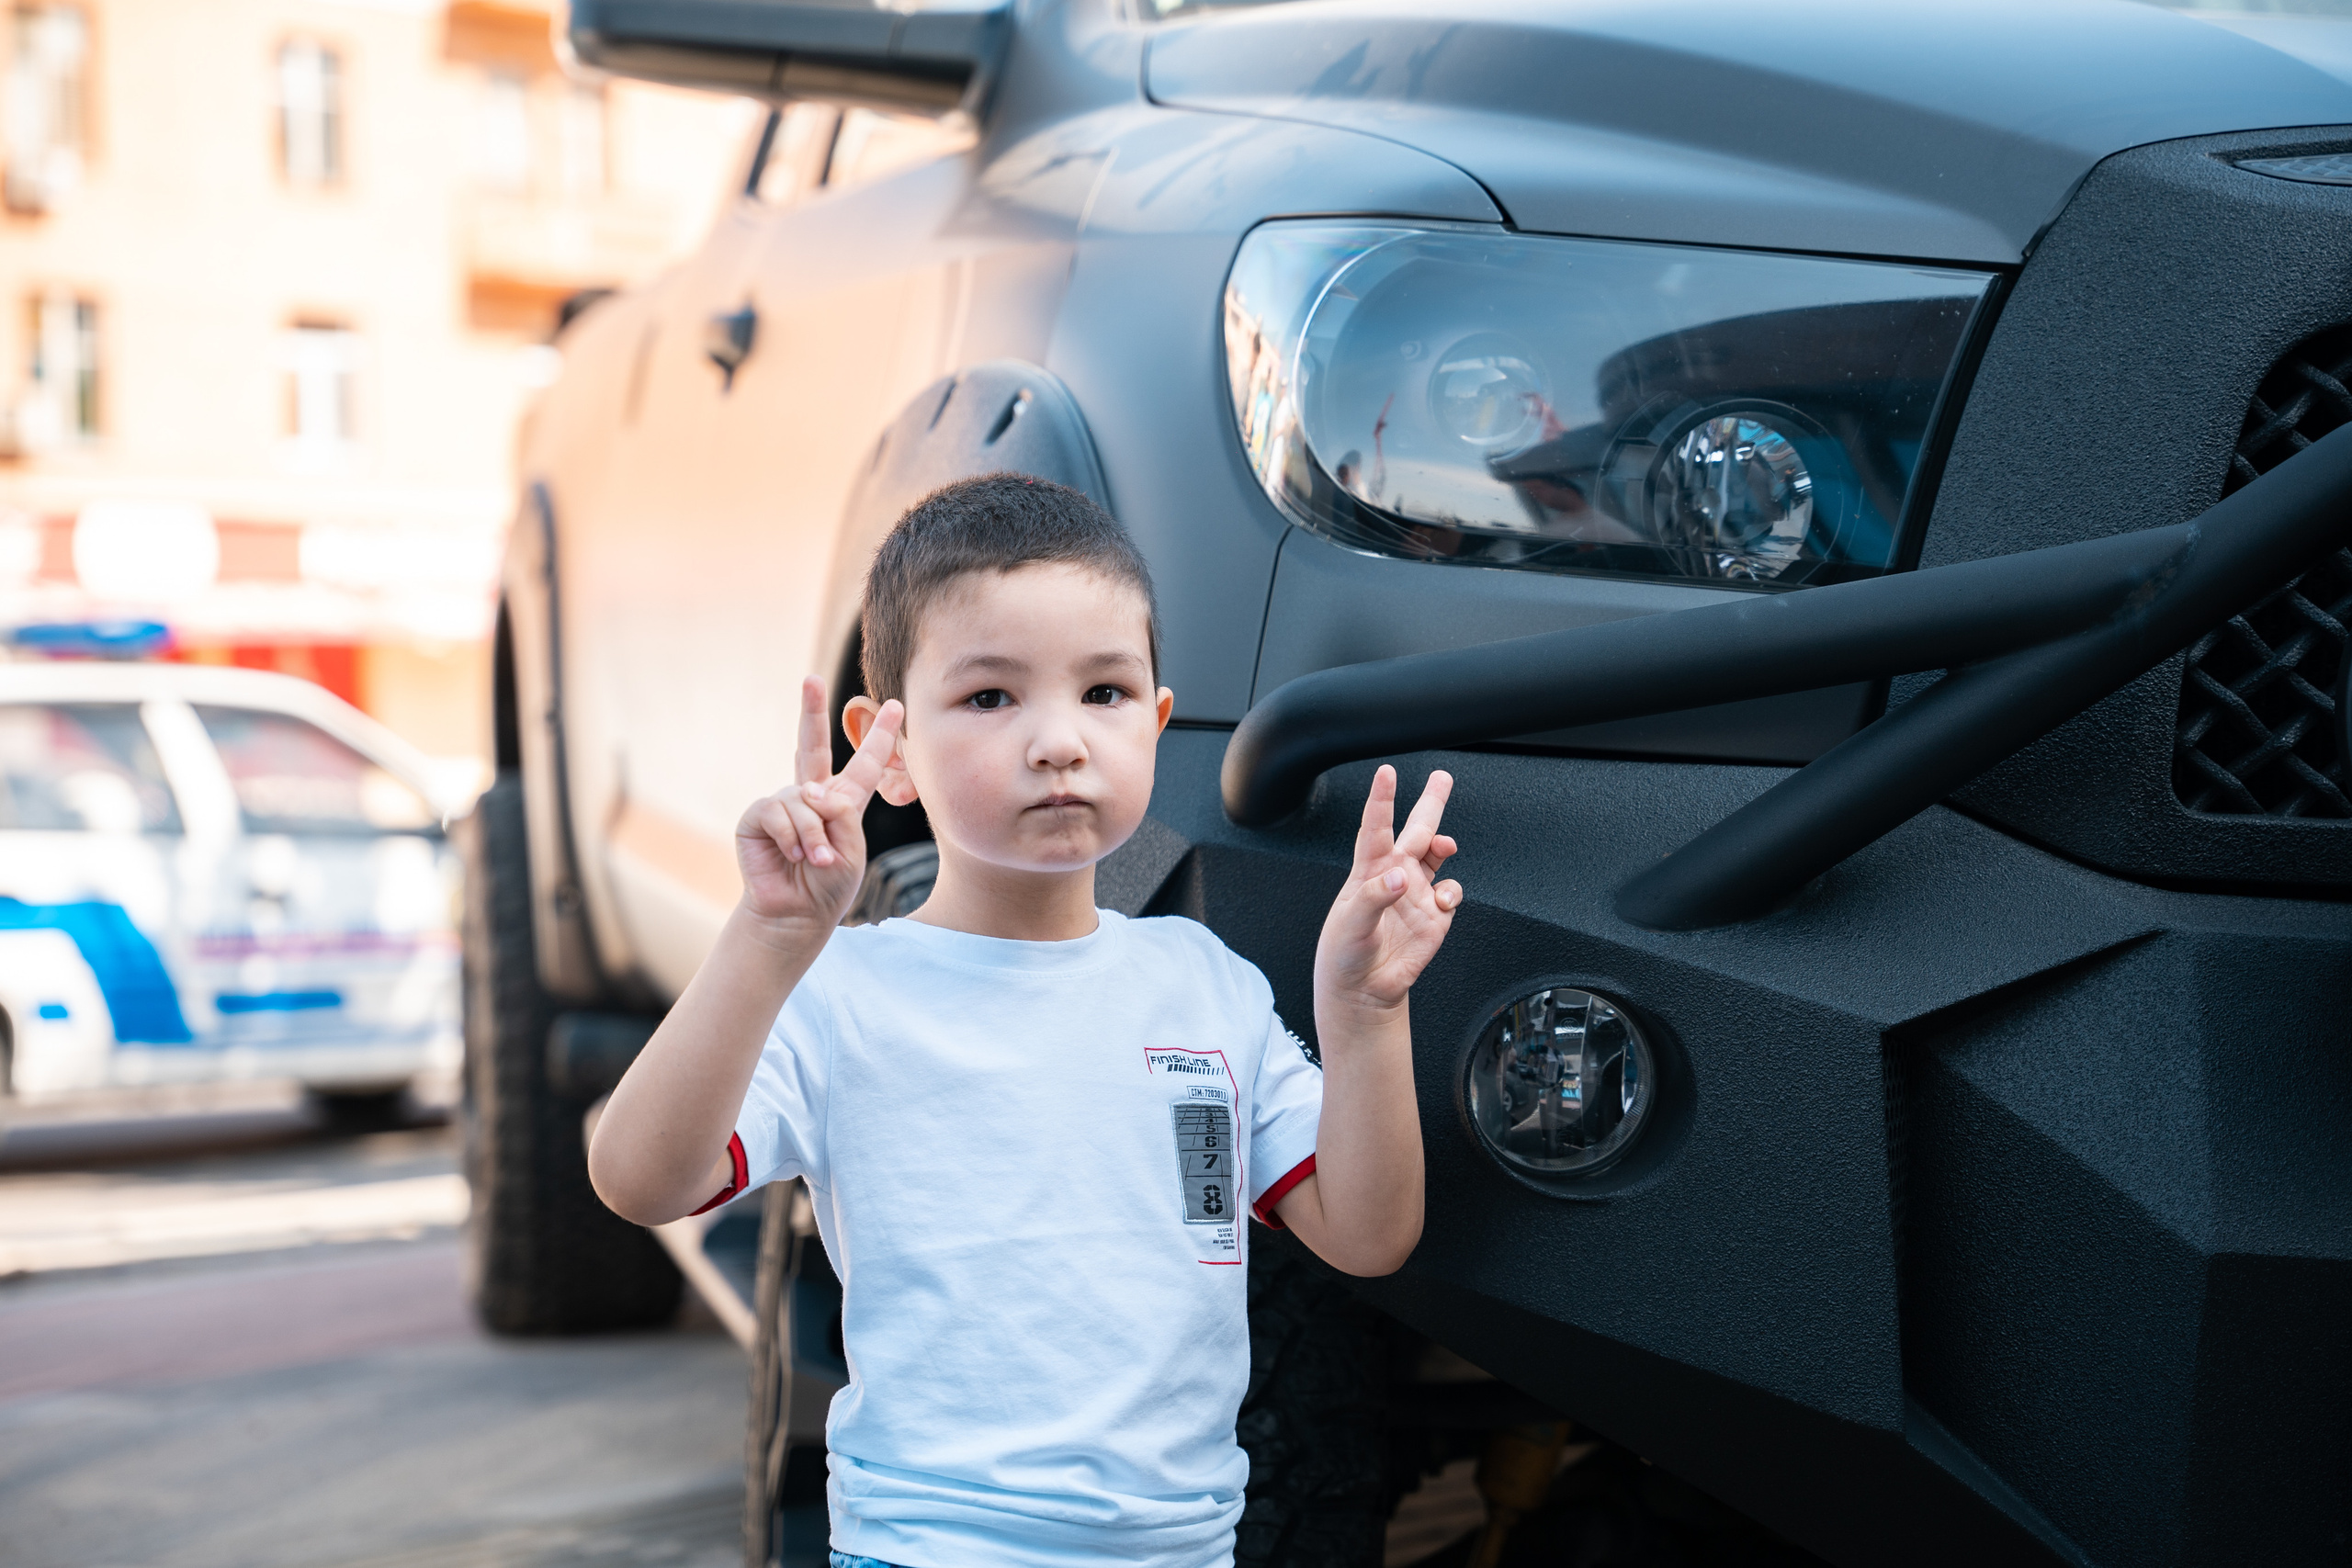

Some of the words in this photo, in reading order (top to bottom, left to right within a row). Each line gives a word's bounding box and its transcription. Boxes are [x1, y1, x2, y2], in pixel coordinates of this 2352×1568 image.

[1150, 1055, 1188, 1065] FINISH
[1187, 1056, 1211, 1067] LINE
[1204, 1135, 1217, 1147] 6
[1204, 1154, 1218, 1169] 7
[1204, 1185, 1223, 1214] 8
